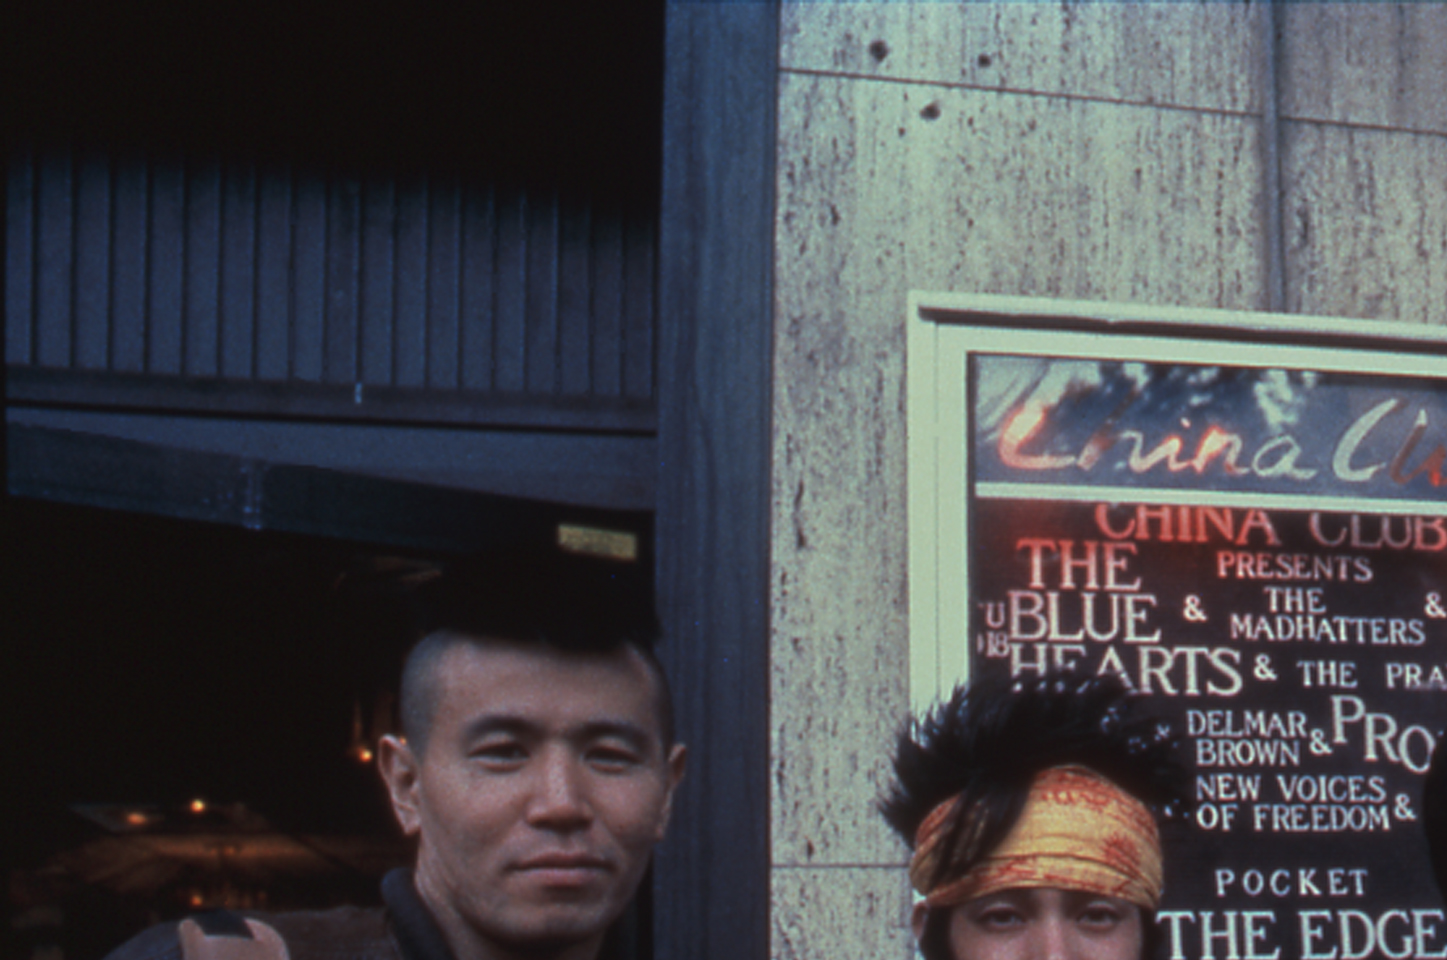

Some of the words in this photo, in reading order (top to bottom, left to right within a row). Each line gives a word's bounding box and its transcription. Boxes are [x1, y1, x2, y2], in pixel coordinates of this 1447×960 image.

[1094, 503, 1281, 545] CHINA
[1017, 537, 1142, 590] THE
[1215, 548, 1374, 583] PRESENTS
[1008, 590, 1162, 643] BLUE
[1182, 594, 1208, 623] &
[1263, 586, 1327, 616] THE
[1423, 591, 1447, 623] &
[1229, 614, 1426, 646] MADHATTERS
[1010, 643, 1244, 695] HEARTS
[1252, 653, 1278, 682] &
[1296, 659, 1359, 689] THE
[1186, 709, 1306, 738] DELMAR
[1332, 695, 1436, 774] PRO
[1196, 737, 1300, 767] BROWN
[1310, 730, 1332, 756] &
[1196, 774, 1261, 802] NEW
[1277, 774, 1387, 804] VOICES
[1195, 799, 1239, 832] OF
[1252, 803, 1390, 832] FREEDOM
[1393, 792, 1417, 821] &
[1214, 867, 1368, 898] POCKET
